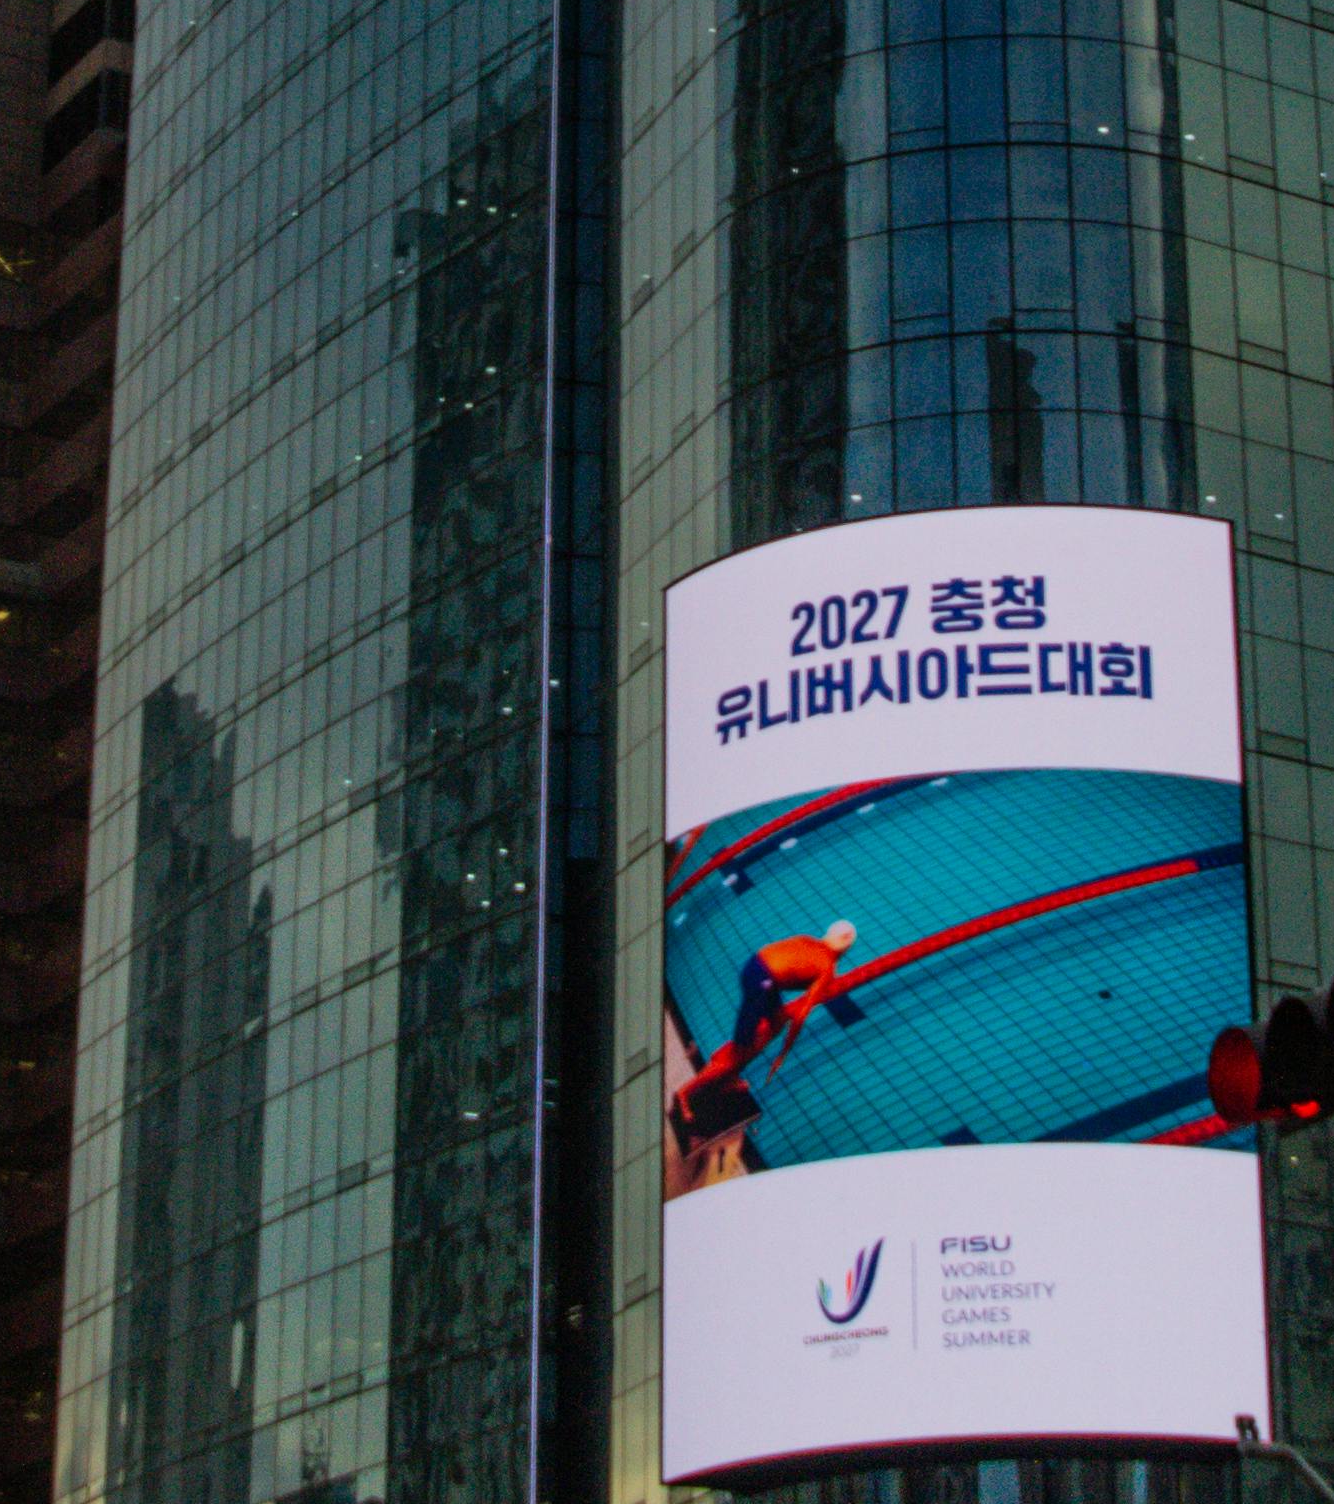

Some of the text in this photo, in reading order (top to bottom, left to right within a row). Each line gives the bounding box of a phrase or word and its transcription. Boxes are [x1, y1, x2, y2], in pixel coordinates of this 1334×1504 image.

[790, 575, 1048, 657] 2027 충청
[715, 641, 1154, 746] 유니버시아드대회
[939, 1235, 1012, 1254] FISU
[940, 1260, 1016, 1278] WORLD
[941, 1281, 1056, 1302] UNIVERSITY
[942, 1305, 1012, 1325] GAMES
[942, 1328, 1031, 1348] SUMMER
